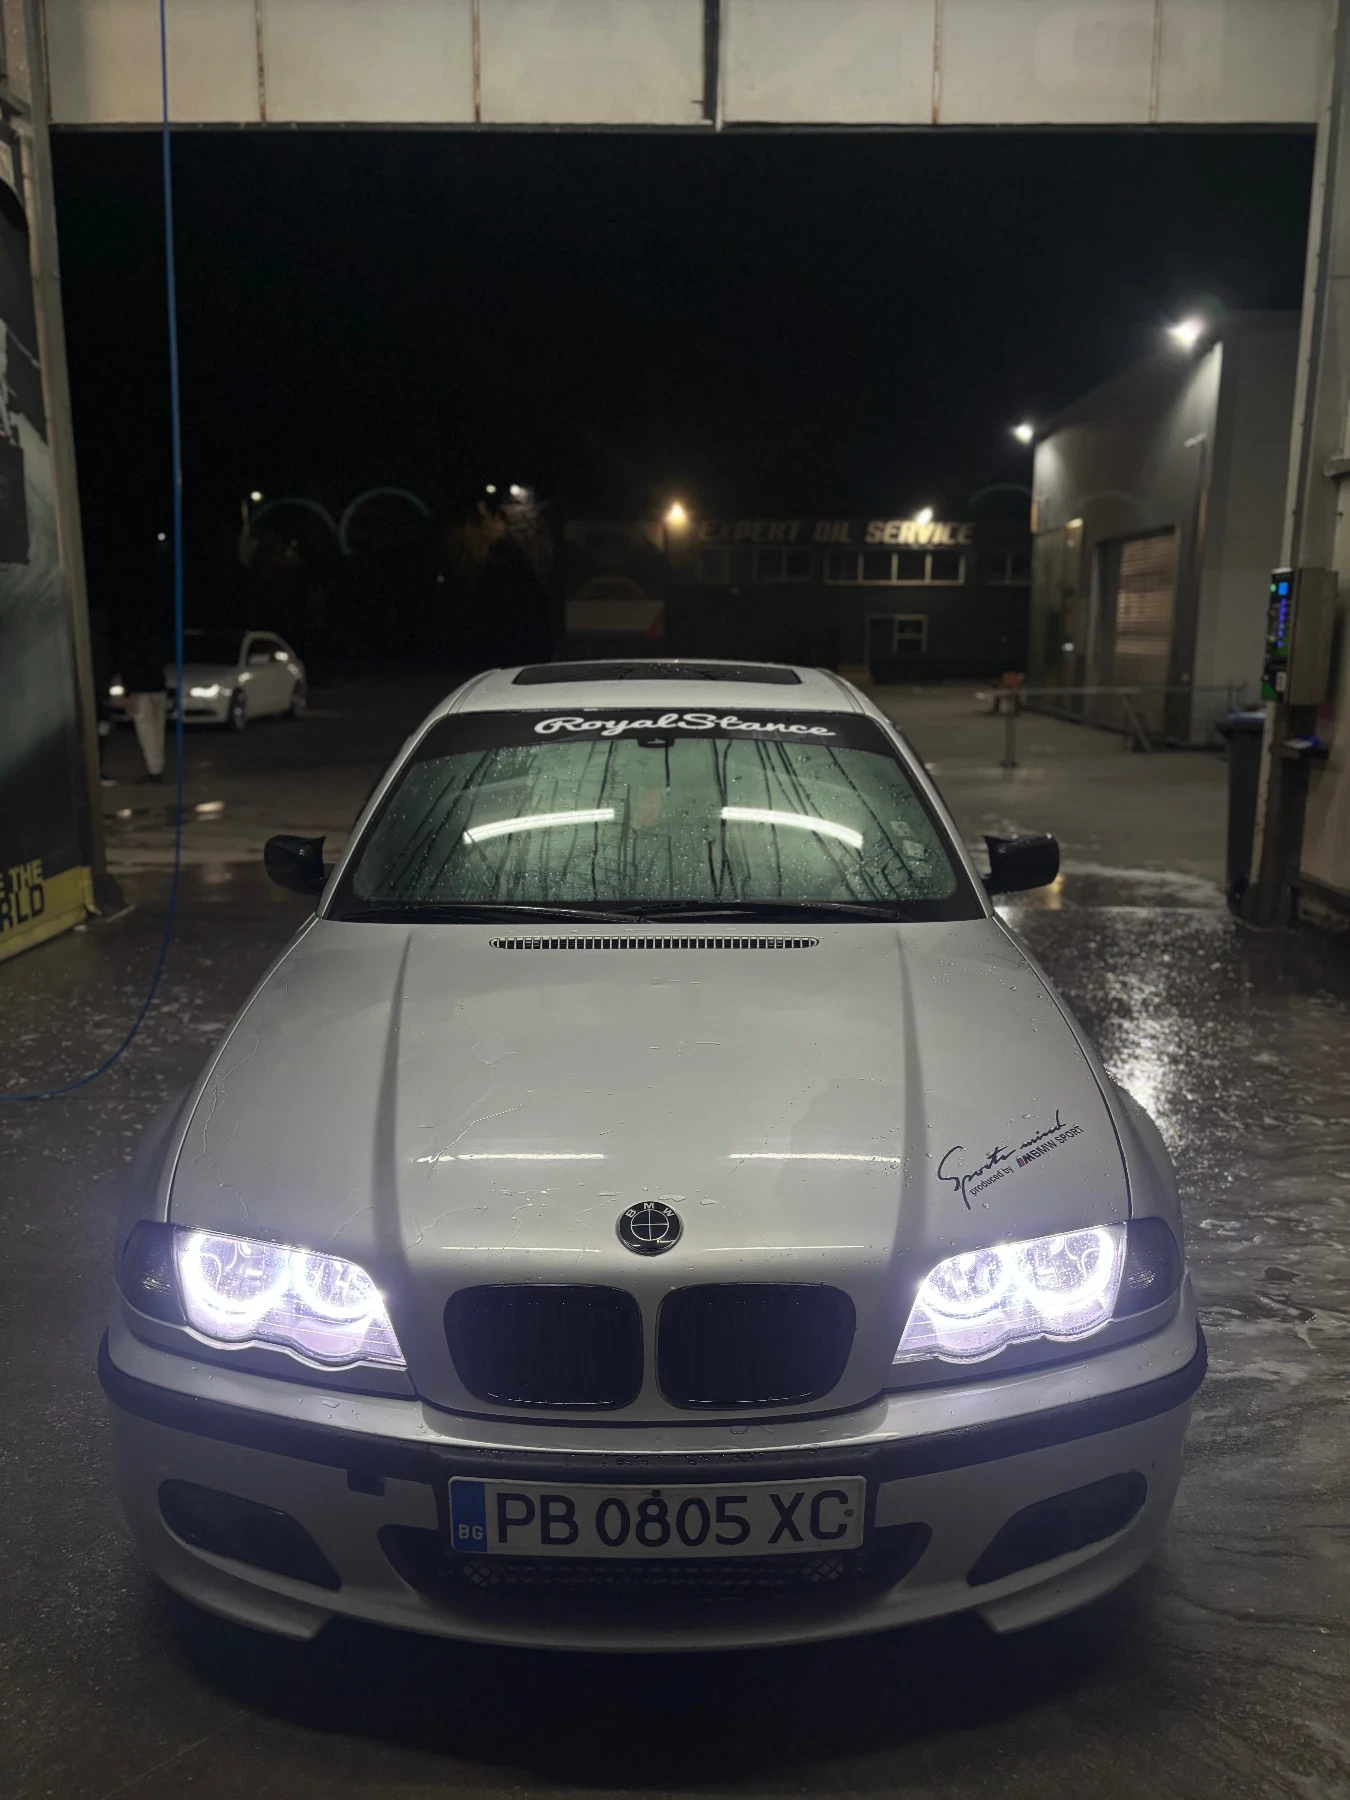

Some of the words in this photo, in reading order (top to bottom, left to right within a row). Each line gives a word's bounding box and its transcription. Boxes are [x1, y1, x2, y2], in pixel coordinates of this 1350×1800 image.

[698, 520, 801, 543] EXPERT
[814, 520, 852, 543] OIL
[865, 520, 976, 546] SERVICE
[8, 858, 43, 892] THE
[969, 1170, 1004, 1196] produced
[1001, 1165, 1014, 1177] by
[1054, 1125, 1085, 1144] SPORT
[625, 1202, 674, 1218] BMW
[458, 1524, 484, 1541] BG
[496, 1492, 579, 1545] PB
[595, 1495, 751, 1547] 0805
[767, 1489, 849, 1544] XC
